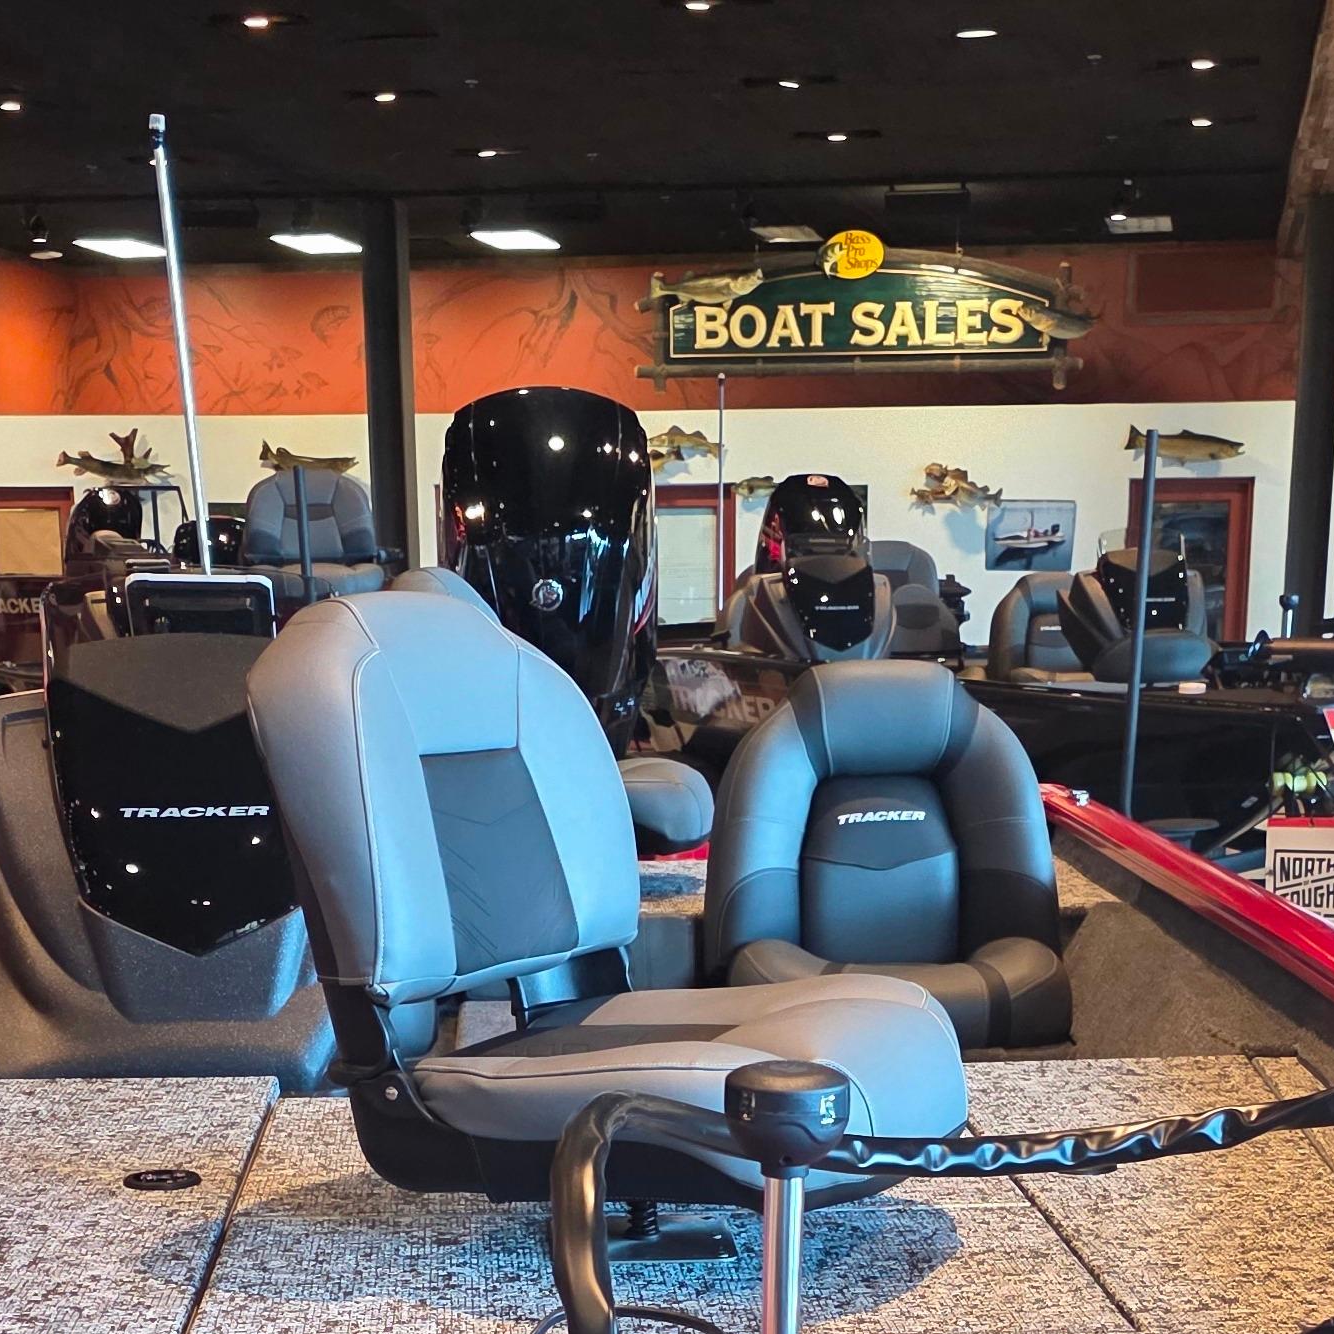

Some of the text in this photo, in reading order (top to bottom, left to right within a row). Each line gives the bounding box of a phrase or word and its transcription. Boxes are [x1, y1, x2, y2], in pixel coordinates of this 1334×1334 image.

[694, 298, 1025, 349] BOAT SALES
[119, 805, 270, 818] TRACKER
[837, 810, 926, 825] TRACKER
